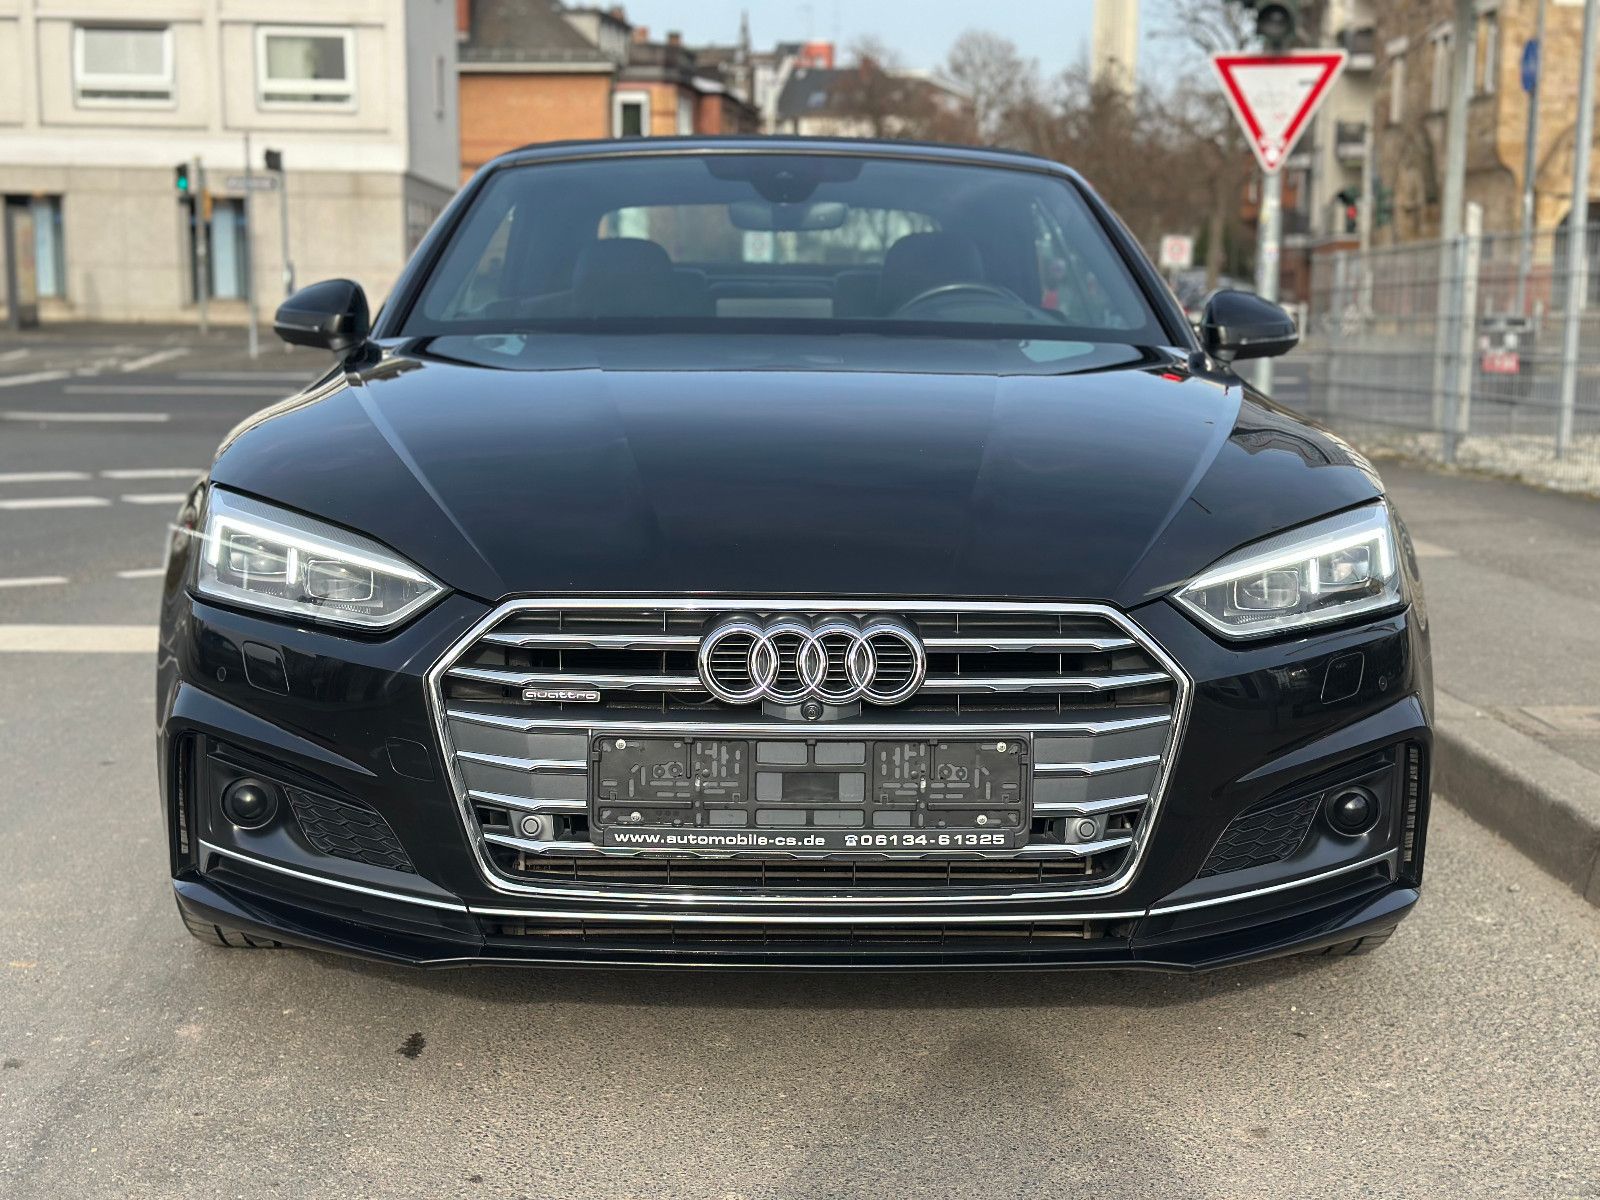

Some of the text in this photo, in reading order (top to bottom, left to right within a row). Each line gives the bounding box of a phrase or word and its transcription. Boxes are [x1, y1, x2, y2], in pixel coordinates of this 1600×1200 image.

[525, 691, 597, 700] quattro
[614, 833, 1006, 846] www.automobile-cs.de 06134-61325
